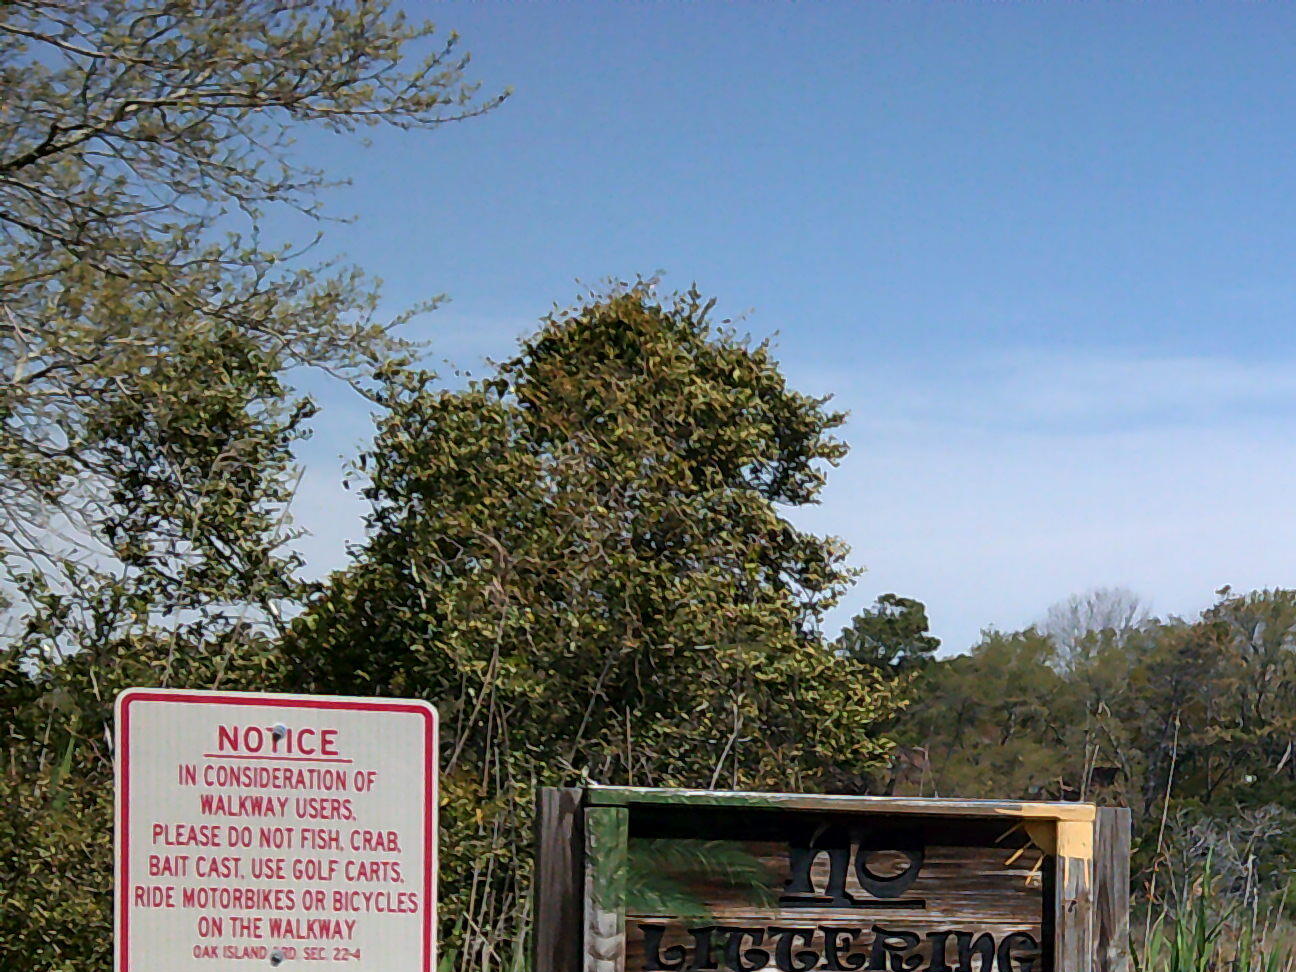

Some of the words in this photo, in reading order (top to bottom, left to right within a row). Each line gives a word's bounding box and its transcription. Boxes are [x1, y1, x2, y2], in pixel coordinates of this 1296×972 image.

[218, 725, 339, 756] NOTICE
[178, 764, 196, 786] IN
[204, 764, 347, 791] CONSIDERATION
[354, 770, 378, 792] OF
[200, 795, 289, 817] WALKWAY
[152, 823, 221, 847] PLEASE
[228, 826, 251, 848] DO
[259, 827, 294, 849] NOT
[149, 855, 190, 877] BAIT
[251, 857, 286, 880] USE
[293, 859, 338, 881] GOLF
[134, 885, 175, 908] RIDE
[182, 886, 296, 911] MOTORBIKES
[302, 889, 326, 911] OR
[333, 890, 419, 914] BICYCLES
[198, 916, 223, 938] ON
[229, 917, 263, 939] THE
[269, 917, 357, 940] WALKWAY
[193, 945, 218, 959] OAK
[223, 945, 267, 960] ISLAND
